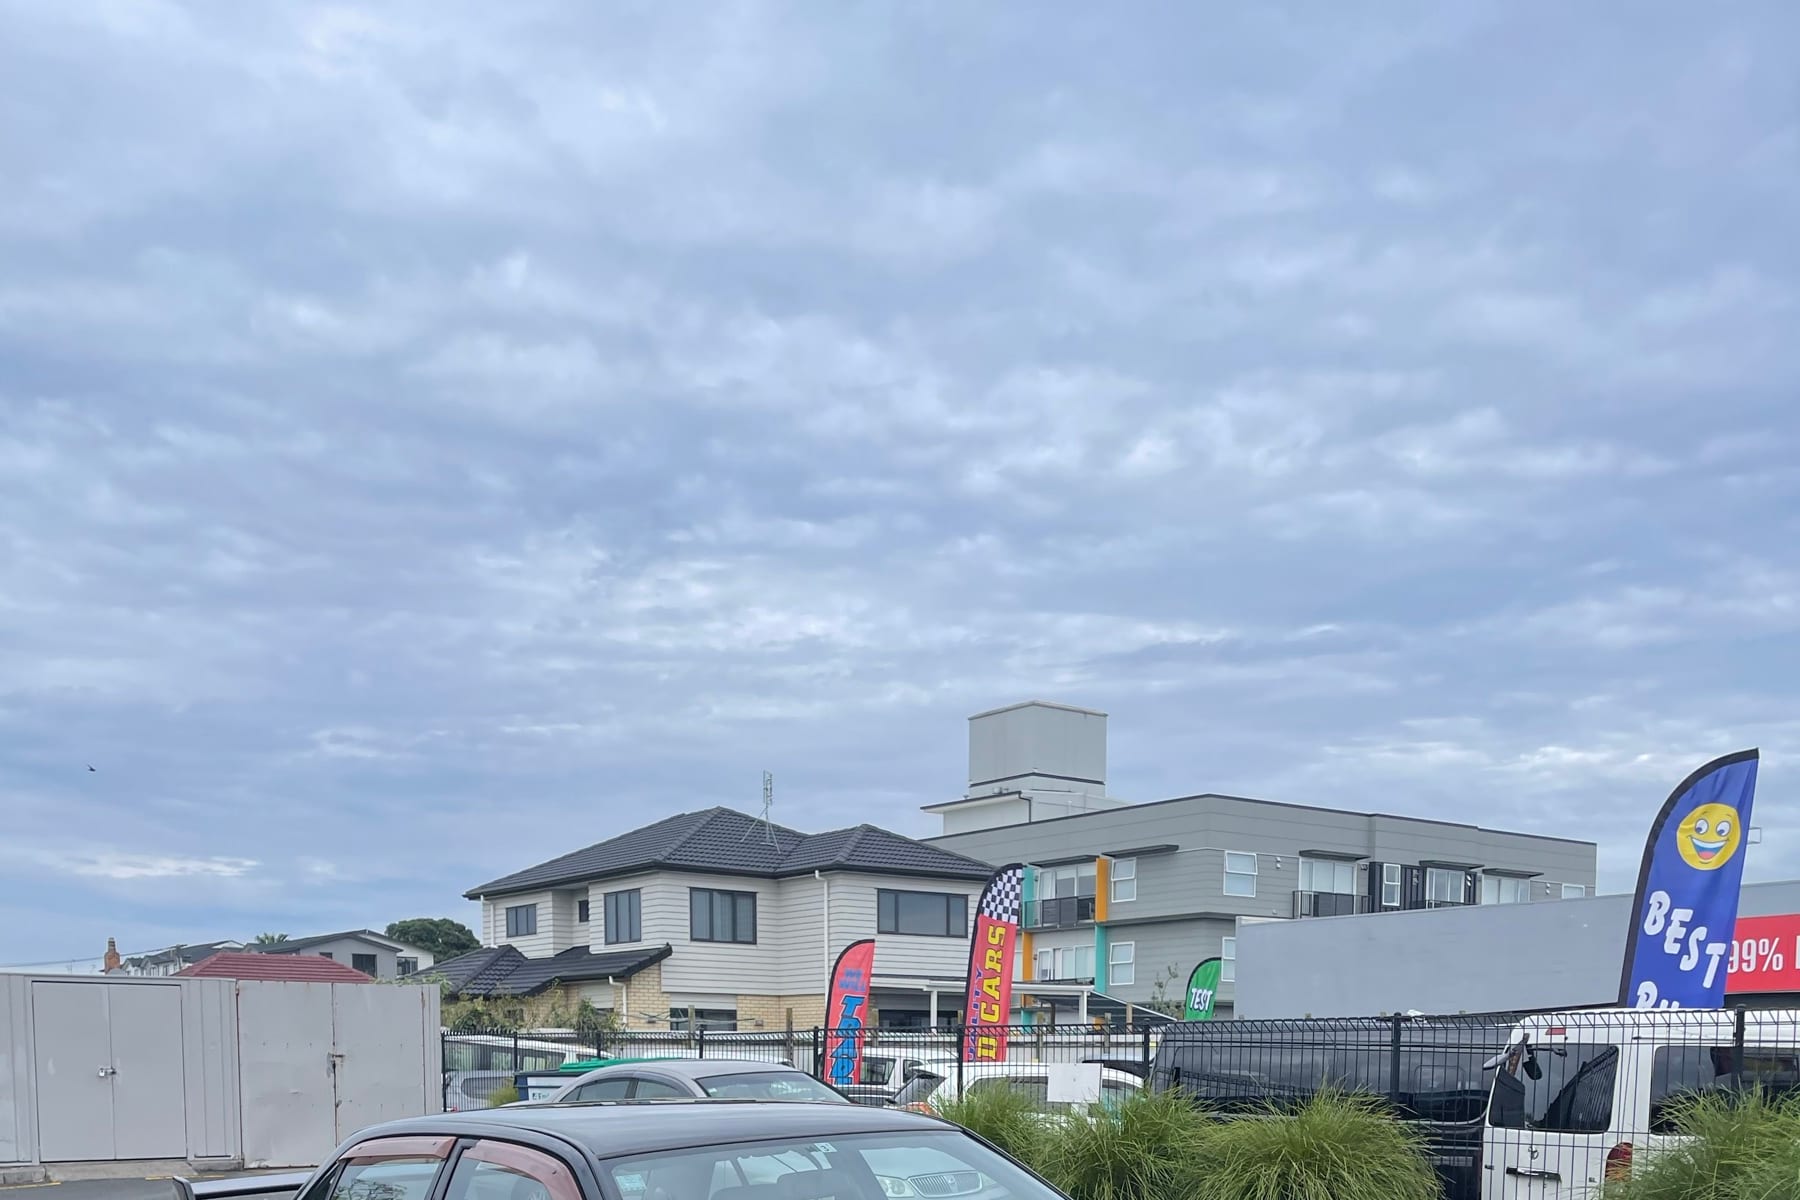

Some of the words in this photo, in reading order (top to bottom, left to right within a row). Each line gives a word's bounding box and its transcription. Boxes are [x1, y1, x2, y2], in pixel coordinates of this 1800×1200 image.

[980, 924, 1007, 1024] CARS
[1643, 890, 1727, 989] BEST
[1190, 987, 1213, 1011] TEST
